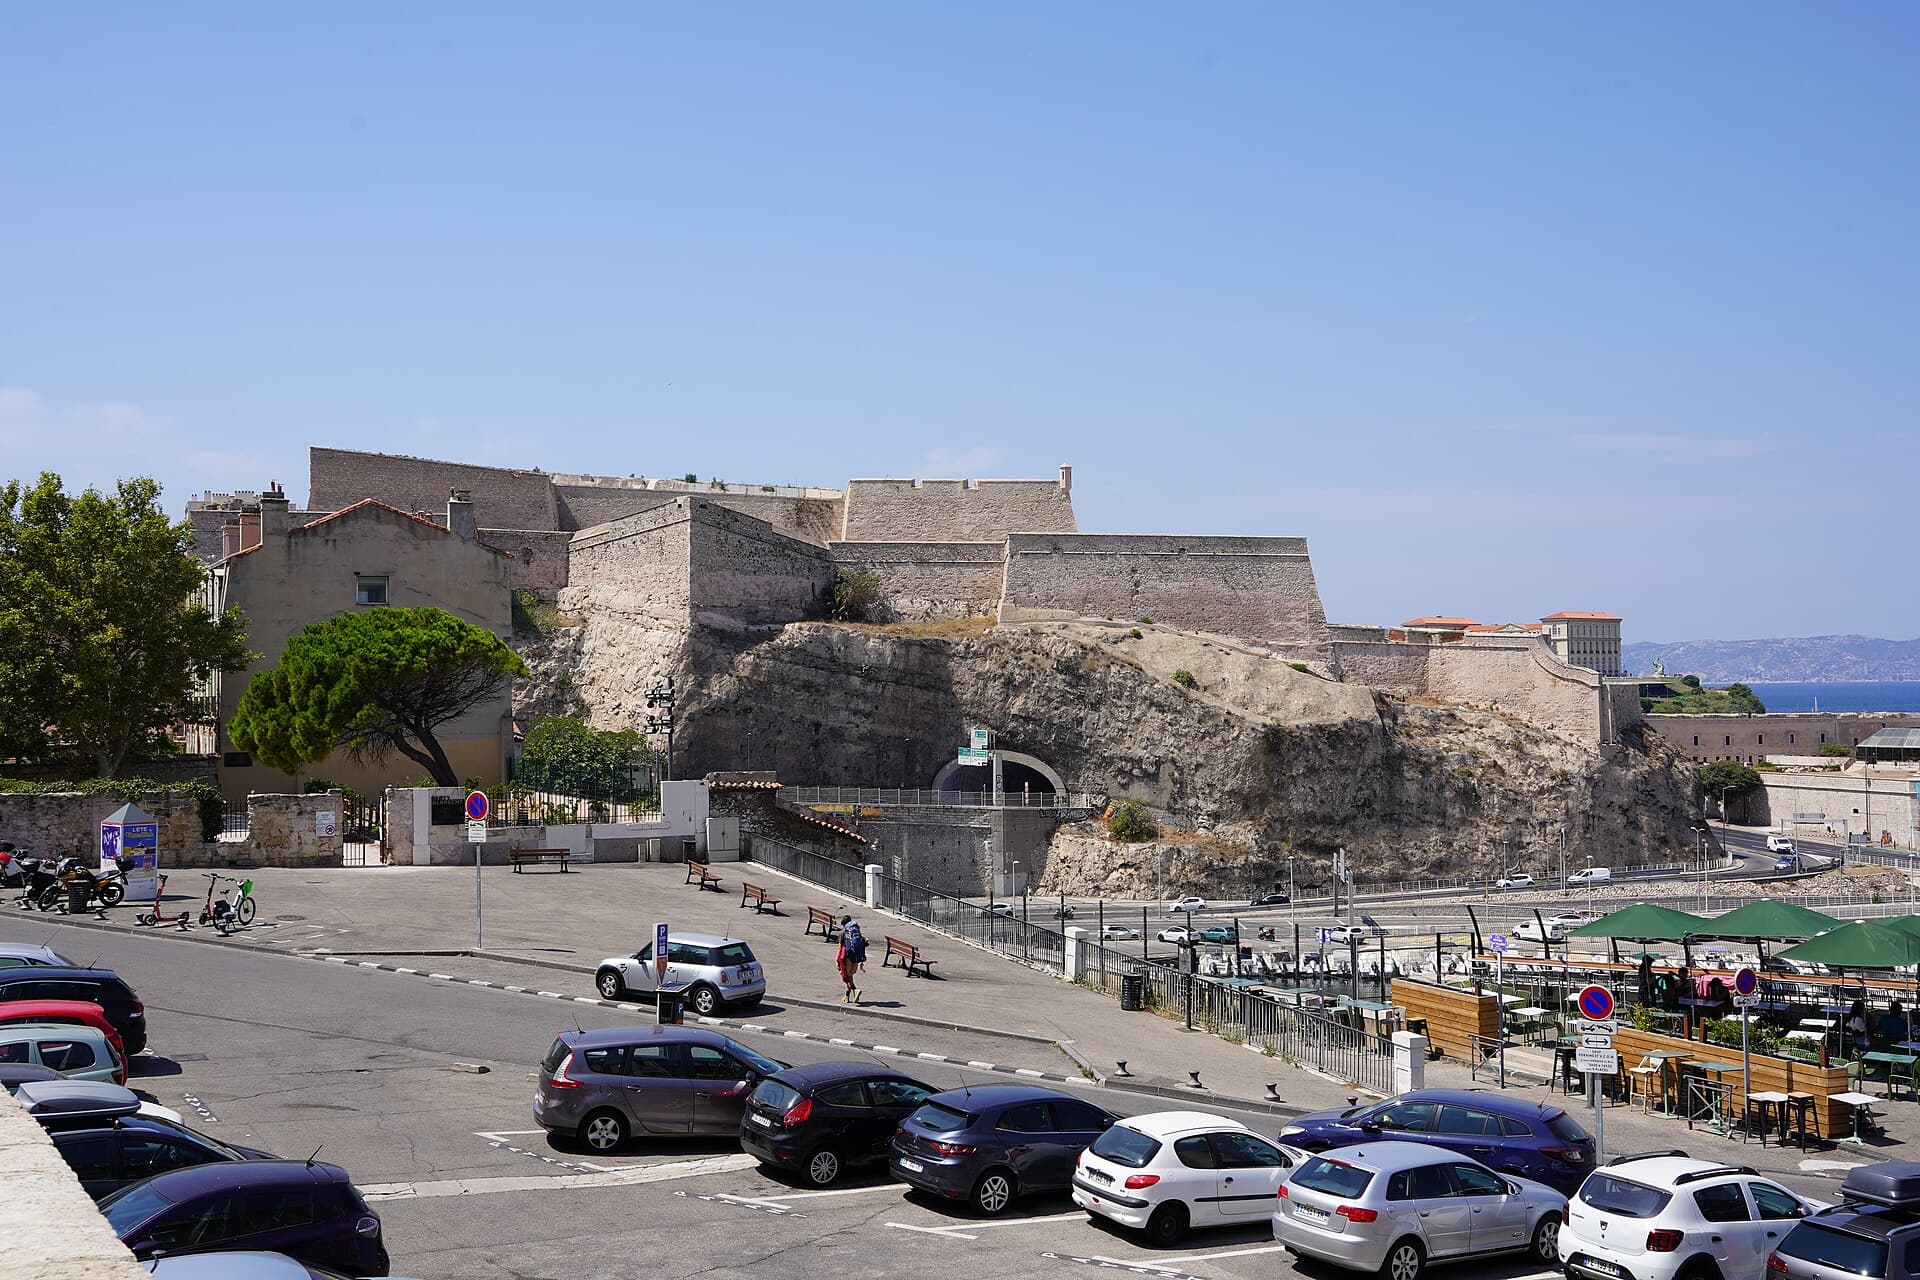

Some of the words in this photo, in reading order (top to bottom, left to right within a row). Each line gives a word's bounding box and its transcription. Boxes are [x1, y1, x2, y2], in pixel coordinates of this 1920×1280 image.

[660, 926, 666, 936] P
[488, 1142, 589, 1173] PAYANT
[672, 1191, 808, 1218] PAYANT
